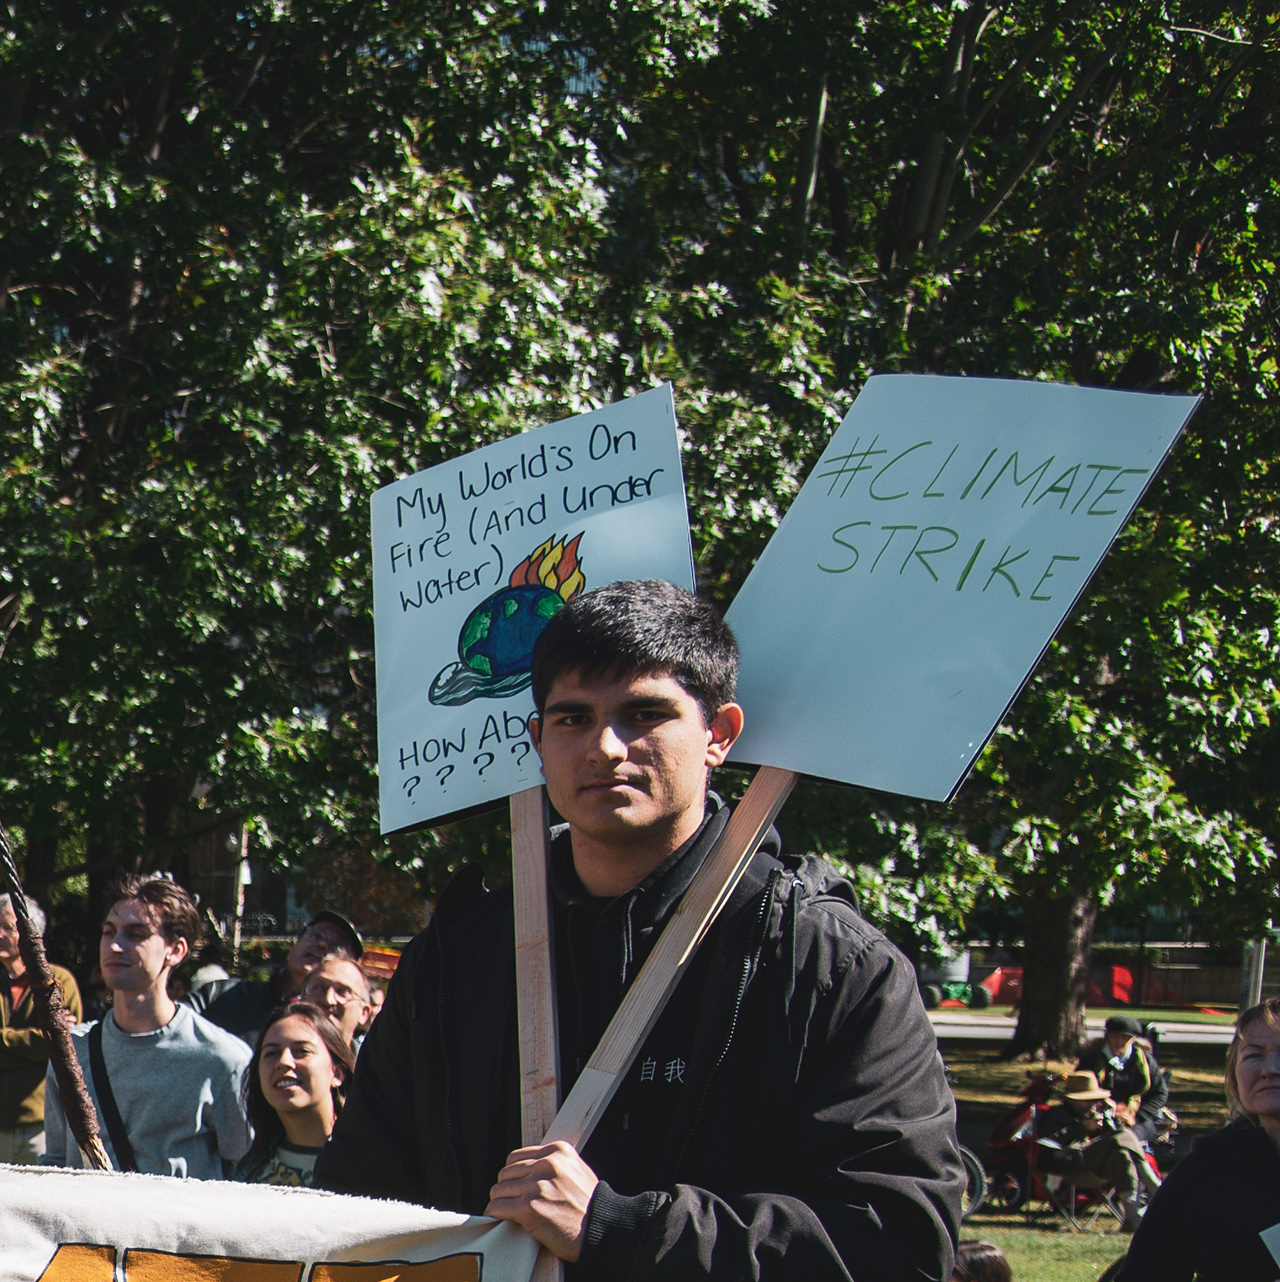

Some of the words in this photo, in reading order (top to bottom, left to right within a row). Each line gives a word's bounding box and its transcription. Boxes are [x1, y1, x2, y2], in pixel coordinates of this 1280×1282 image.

[396, 487, 448, 533] My
[459, 444, 574, 498] World's
[589, 424, 636, 461] On
[816, 434, 1149, 516] #CLIMATE
[390, 529, 453, 574] Fire
[468, 494, 547, 545] (And
[817, 521, 1081, 602] STRIKE
